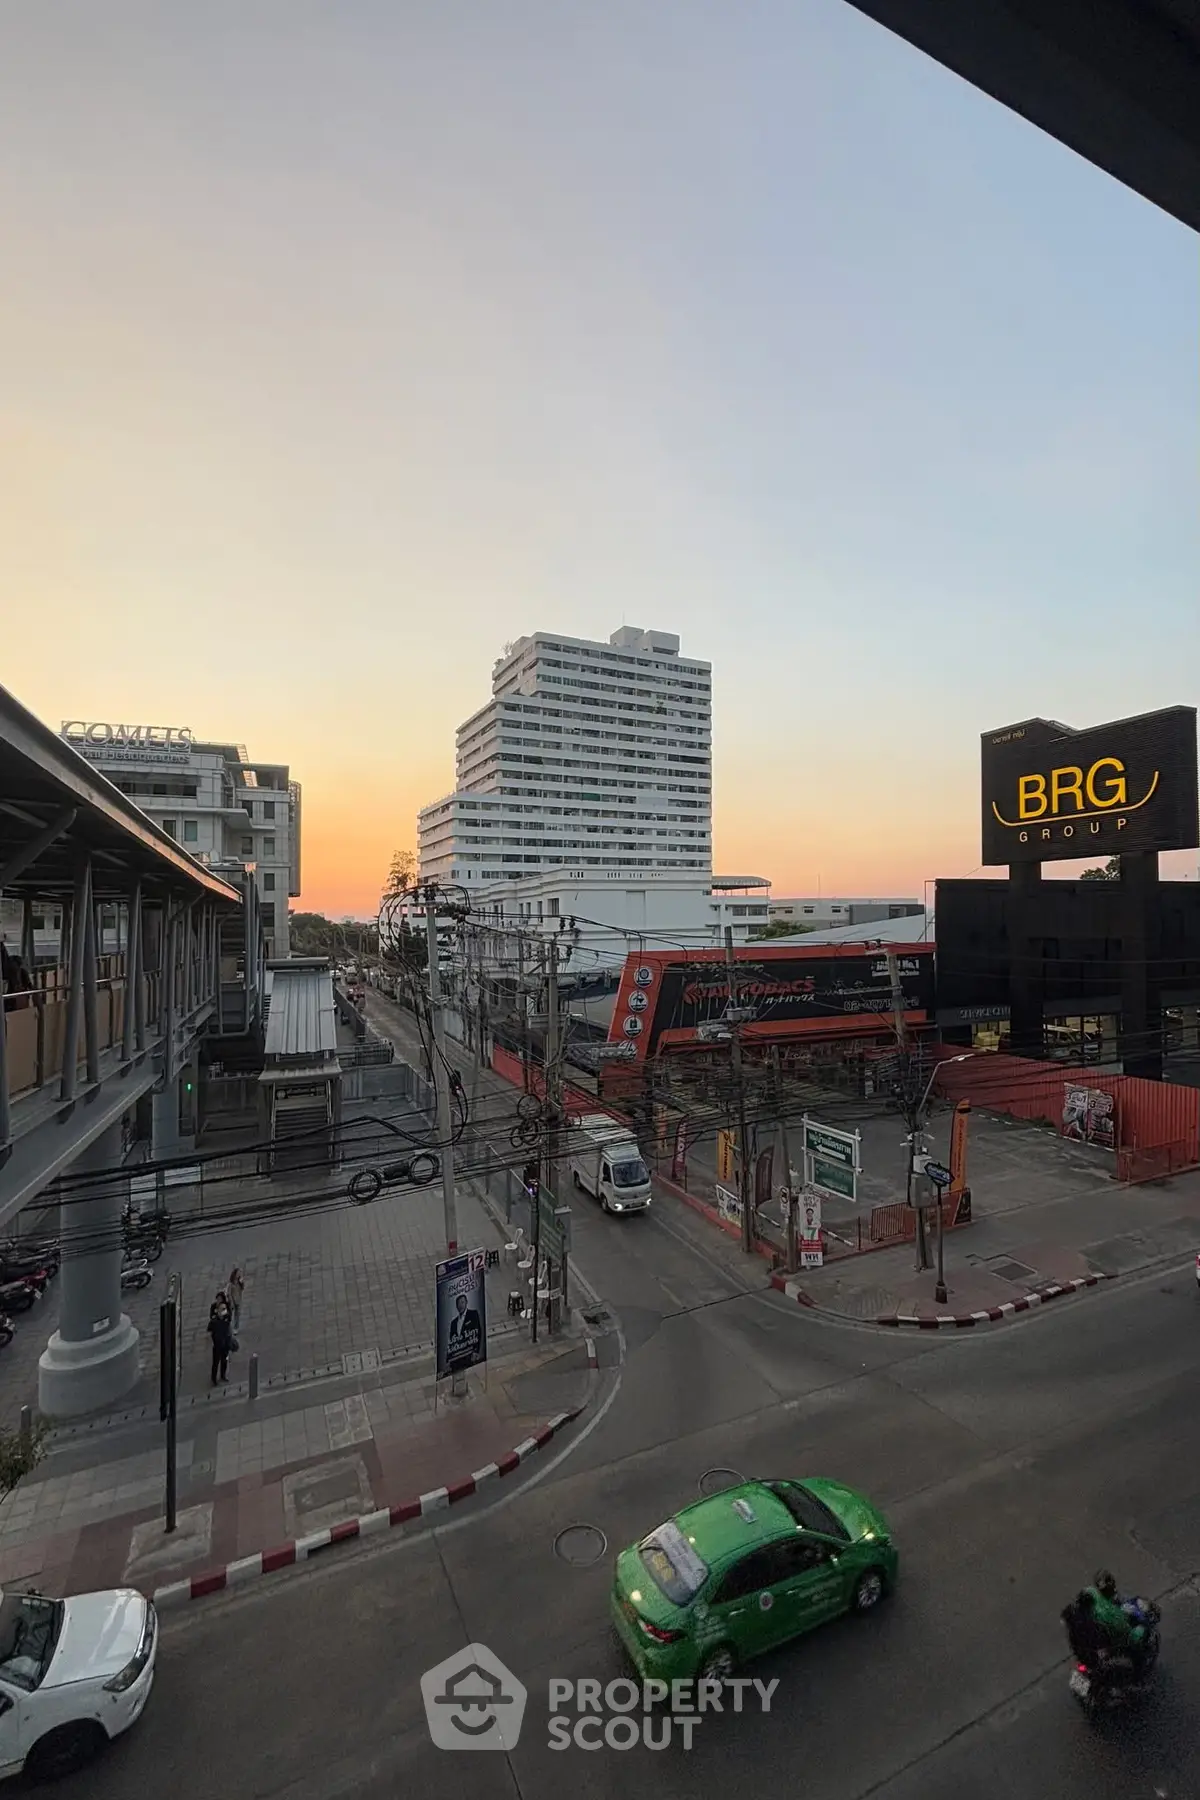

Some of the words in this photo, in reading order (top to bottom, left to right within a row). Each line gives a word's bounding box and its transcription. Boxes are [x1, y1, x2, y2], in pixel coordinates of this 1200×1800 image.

[62, 721, 191, 749] COMETS
[1018, 756, 1126, 819] BRG
[1019, 818, 1127, 842] GROUP
[468, 1255, 484, 1273] 12
